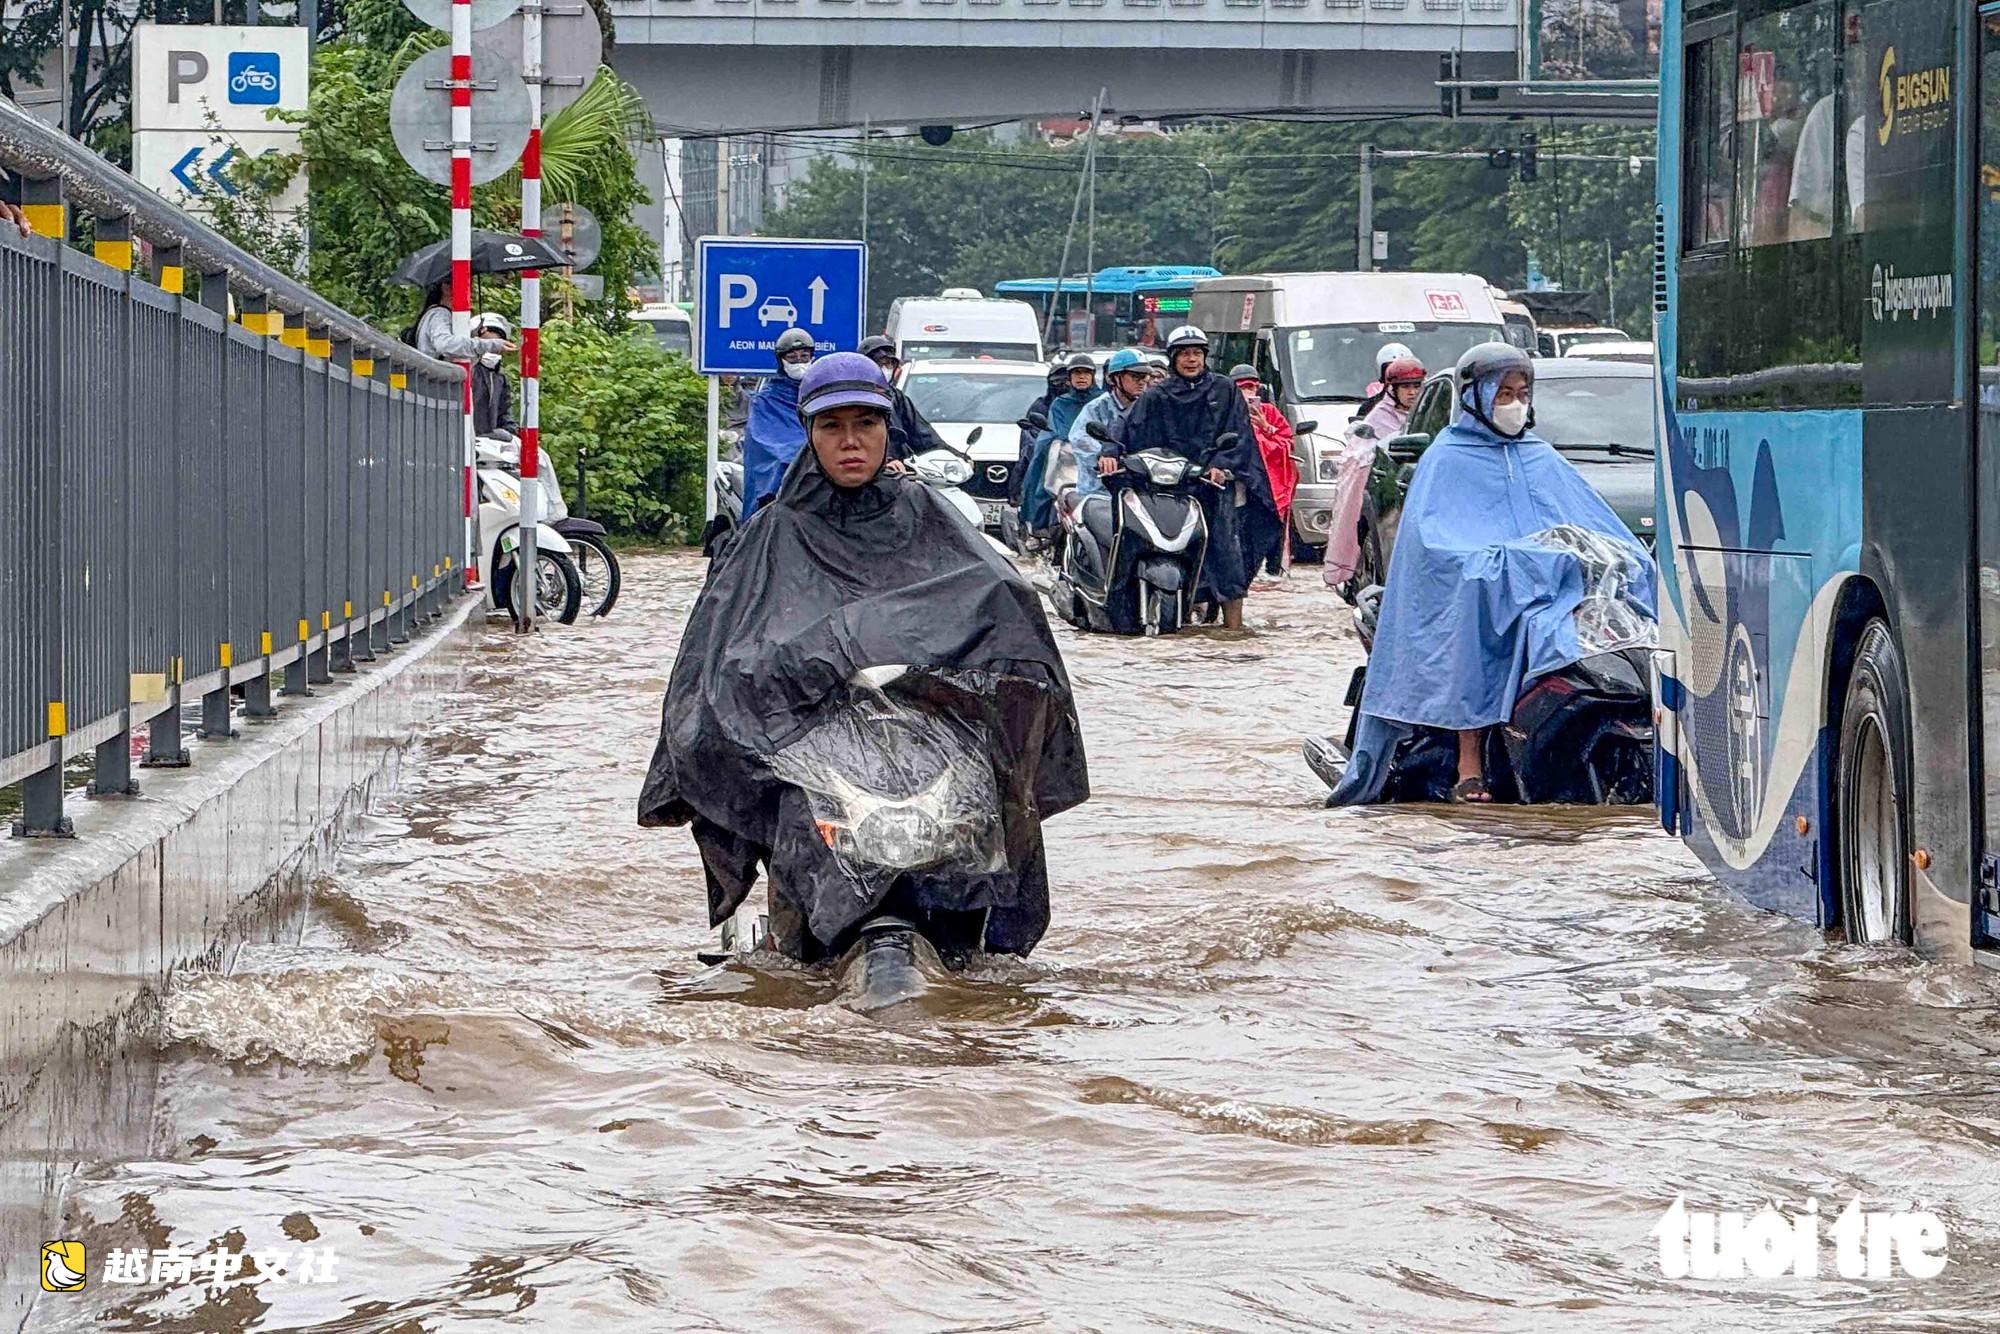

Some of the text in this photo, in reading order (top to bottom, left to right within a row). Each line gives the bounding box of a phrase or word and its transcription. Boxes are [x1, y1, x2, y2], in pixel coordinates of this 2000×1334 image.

[168, 50, 209, 104] P
[1897, 66, 1950, 111] BIGSUN
[718, 273, 758, 329] P
[1884, 263, 1952, 322] bigsungroup.vn
[728, 340, 755, 351] AEON
